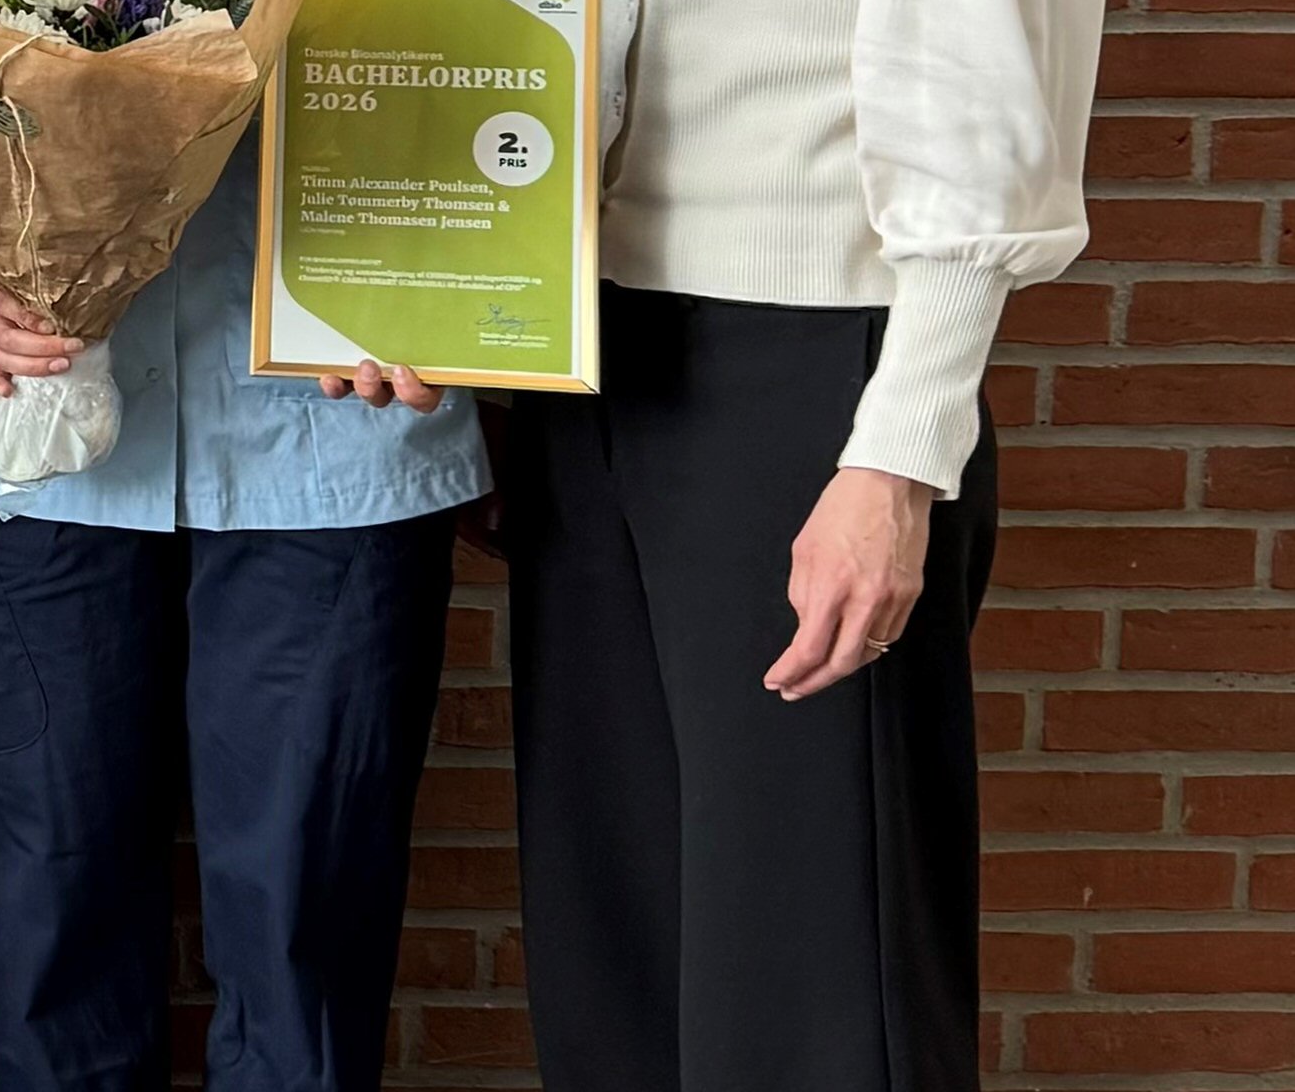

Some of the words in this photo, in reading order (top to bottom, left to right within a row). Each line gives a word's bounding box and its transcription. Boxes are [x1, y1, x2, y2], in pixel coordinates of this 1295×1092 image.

[304, 48, 349, 60] Danske
[351, 49, 444, 62] Bioanalytikeres
[304, 63, 547, 91] BACHELORPRIS
[303, 90, 378, 112] 2026
[497, 132, 529, 154] 2.
[499, 158, 528, 168] PRIS
[301, 175, 346, 188] Timm
[349, 177, 425, 191] Alexander
[429, 180, 494, 196] Poulsen,
[300, 193, 334, 206] Julie
[338, 194, 420, 211] Tømmerby
[423, 197, 494, 212] Thomsen
[497, 201, 510, 212] &
[301, 211, 355, 224] Malene
[357, 212, 436, 227] Thomasen
[441, 216, 491, 229] Jensen
